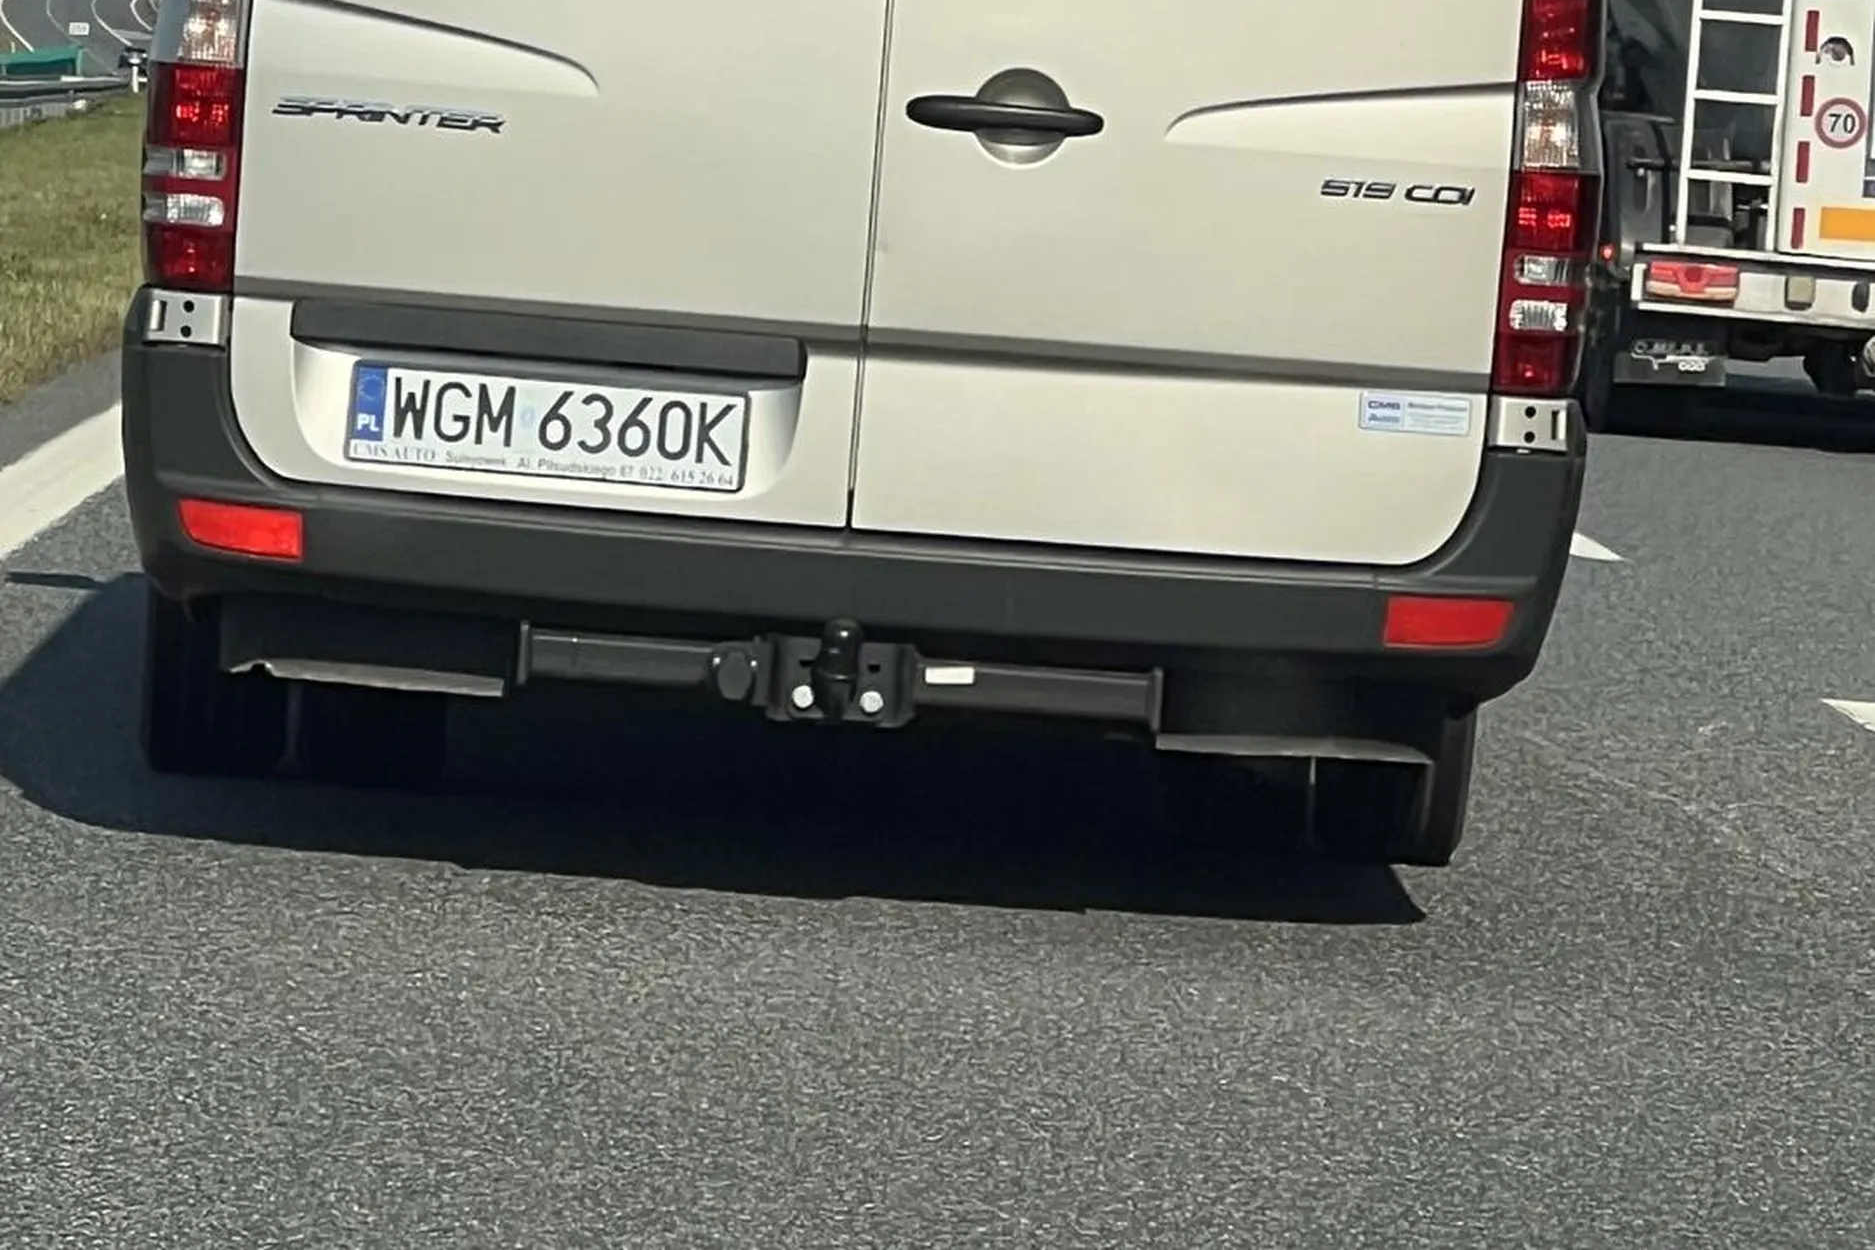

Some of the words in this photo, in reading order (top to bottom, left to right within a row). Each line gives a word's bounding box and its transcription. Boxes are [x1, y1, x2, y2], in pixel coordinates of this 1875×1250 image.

[272, 96, 506, 134] SPRINTER
[1828, 113, 1856, 134] 70
[1320, 179, 1397, 200] 519
[1404, 185, 1476, 206] CDI
[357, 413, 379, 432] PL
[393, 376, 517, 448] WGM
[538, 390, 738, 468] 6360K
[353, 444, 388, 458] CMS
[392, 447, 436, 462] AUTO
